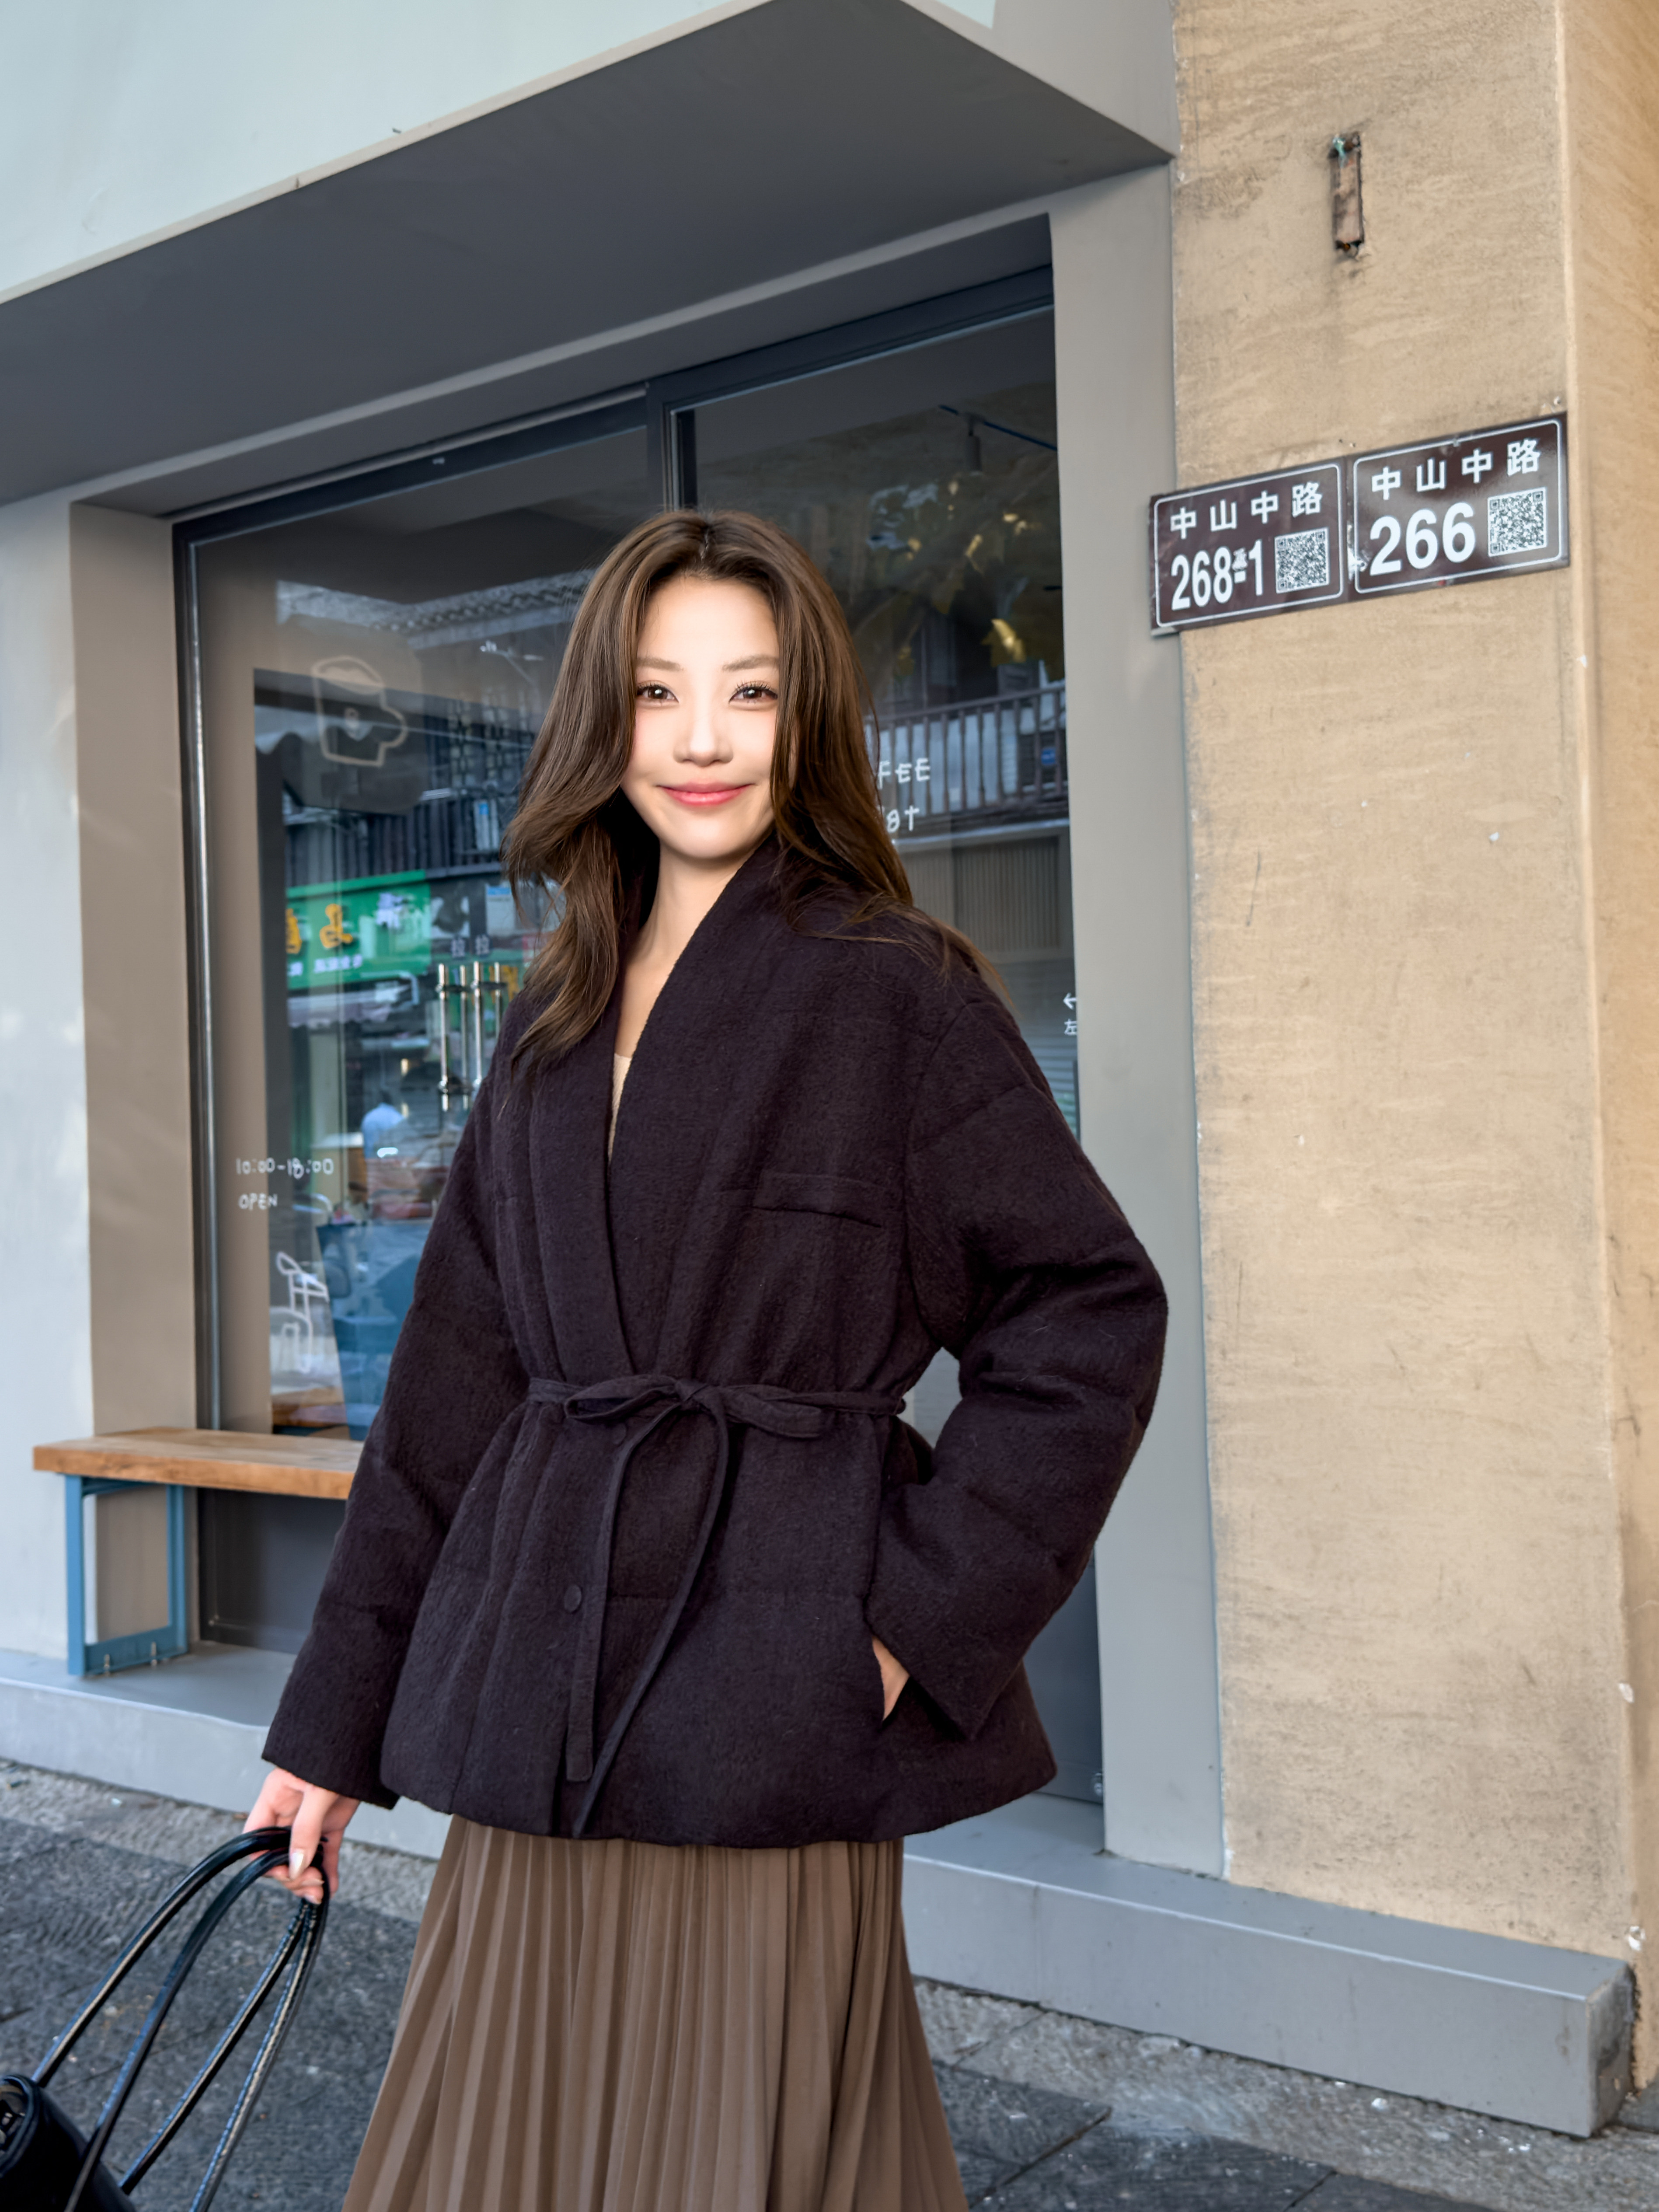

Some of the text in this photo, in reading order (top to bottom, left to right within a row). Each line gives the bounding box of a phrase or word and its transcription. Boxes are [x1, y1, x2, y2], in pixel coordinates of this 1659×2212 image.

[1371, 439, 1540, 500] 中山中路
[1171, 481, 1322, 539] 中山中路
[1370, 502, 1475, 576] 266
[238, 1193, 278, 1211] OPEN
